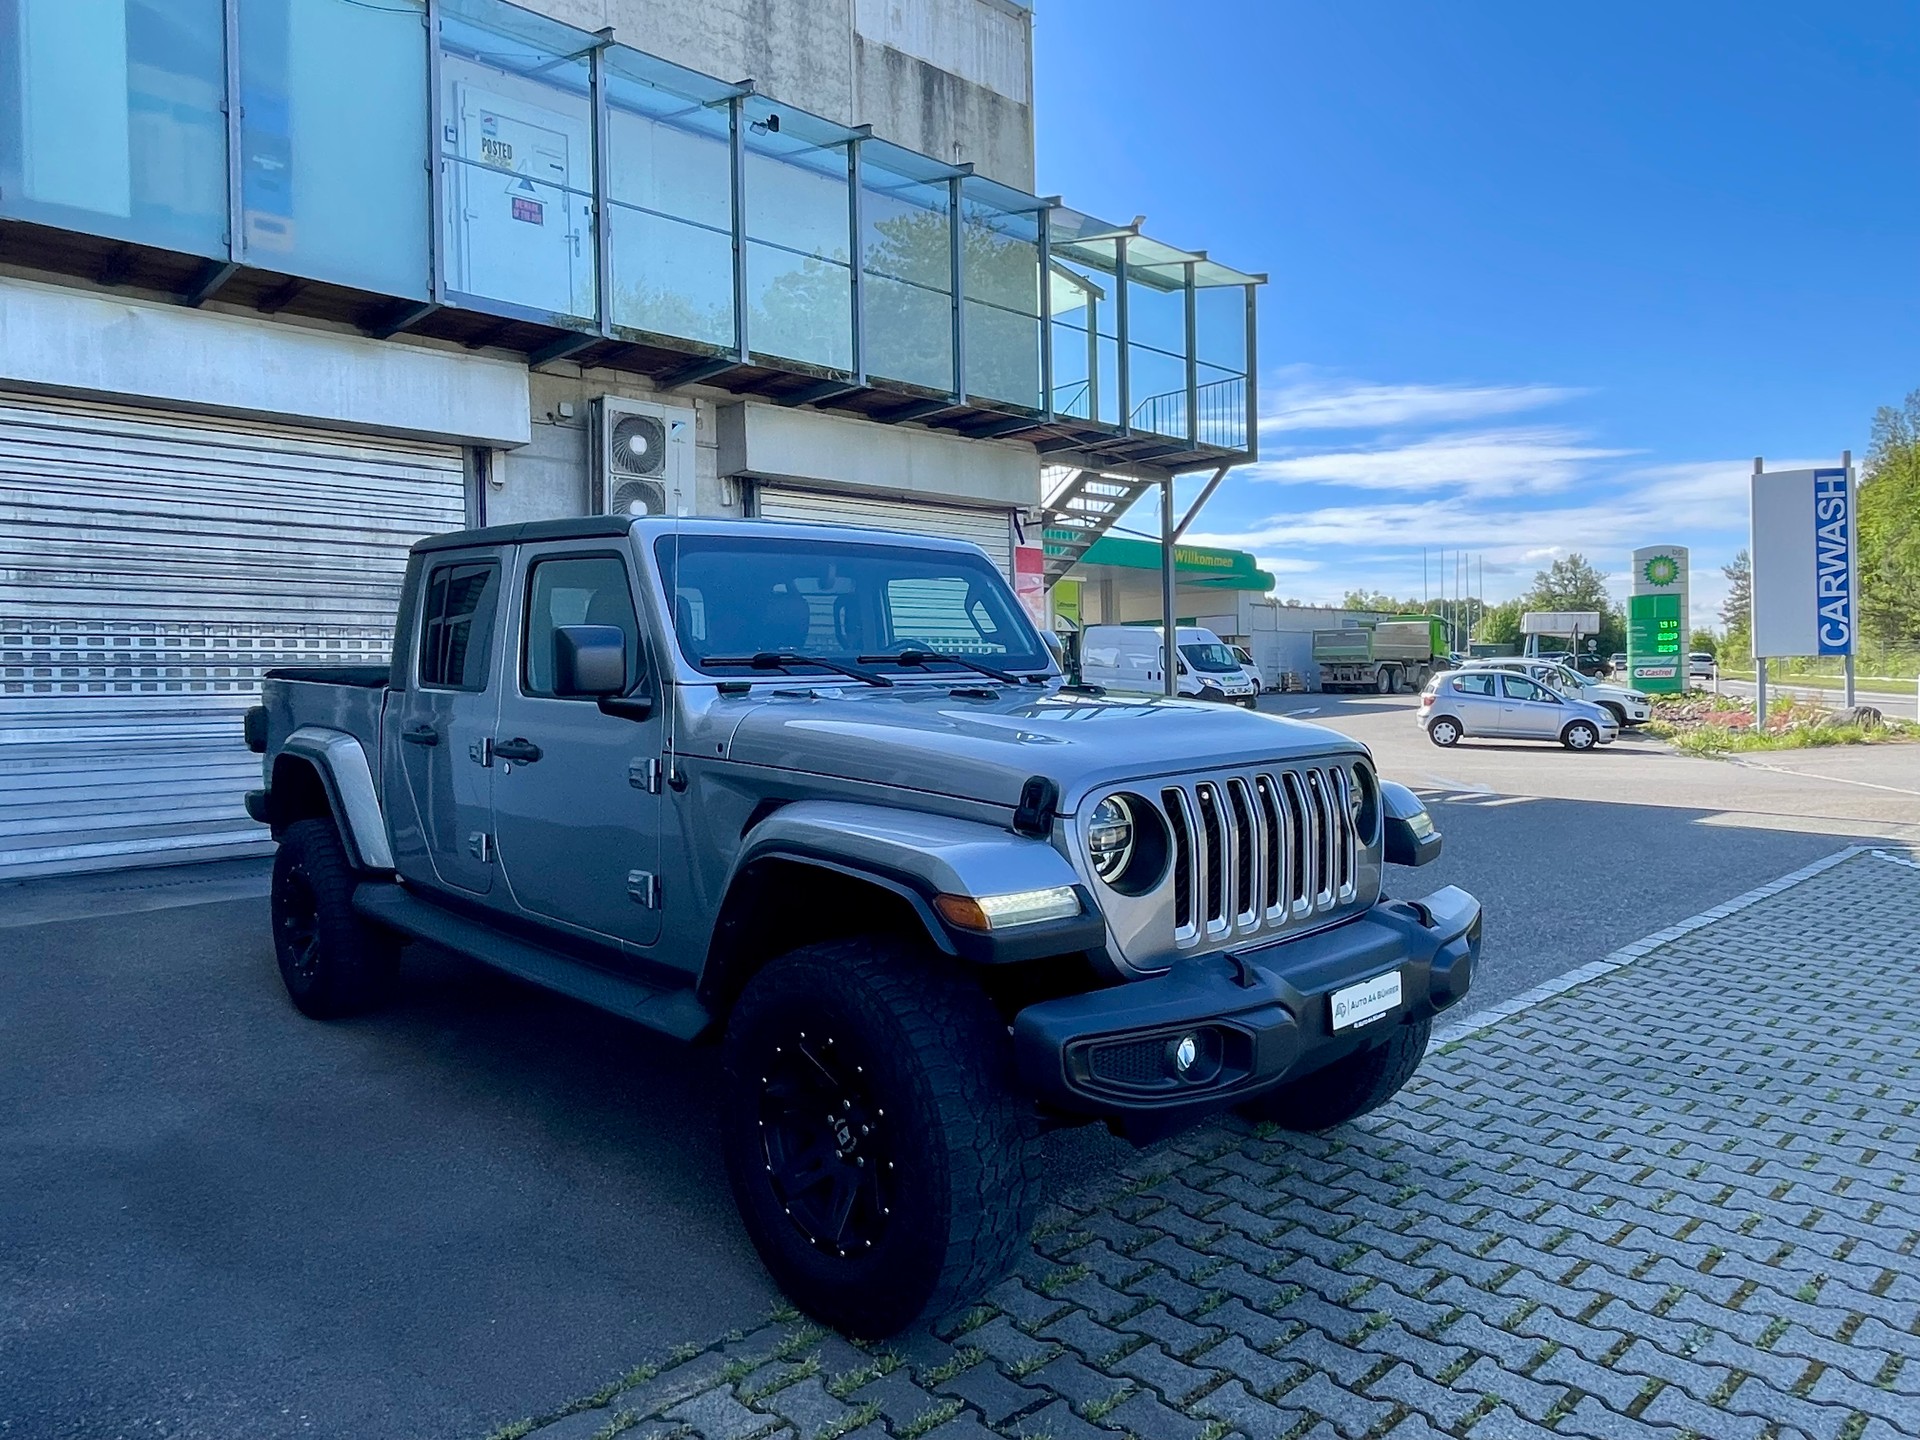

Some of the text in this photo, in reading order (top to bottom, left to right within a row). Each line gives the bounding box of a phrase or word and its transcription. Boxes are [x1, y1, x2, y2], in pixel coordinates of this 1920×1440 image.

[482, 137, 513, 160] POSTED
[1174, 548, 1234, 568] Willkommen
[1816, 474, 1850, 647] CARWASH
[1645, 669, 1673, 677] Castrol
[1368, 992, 1377, 1003] A4
